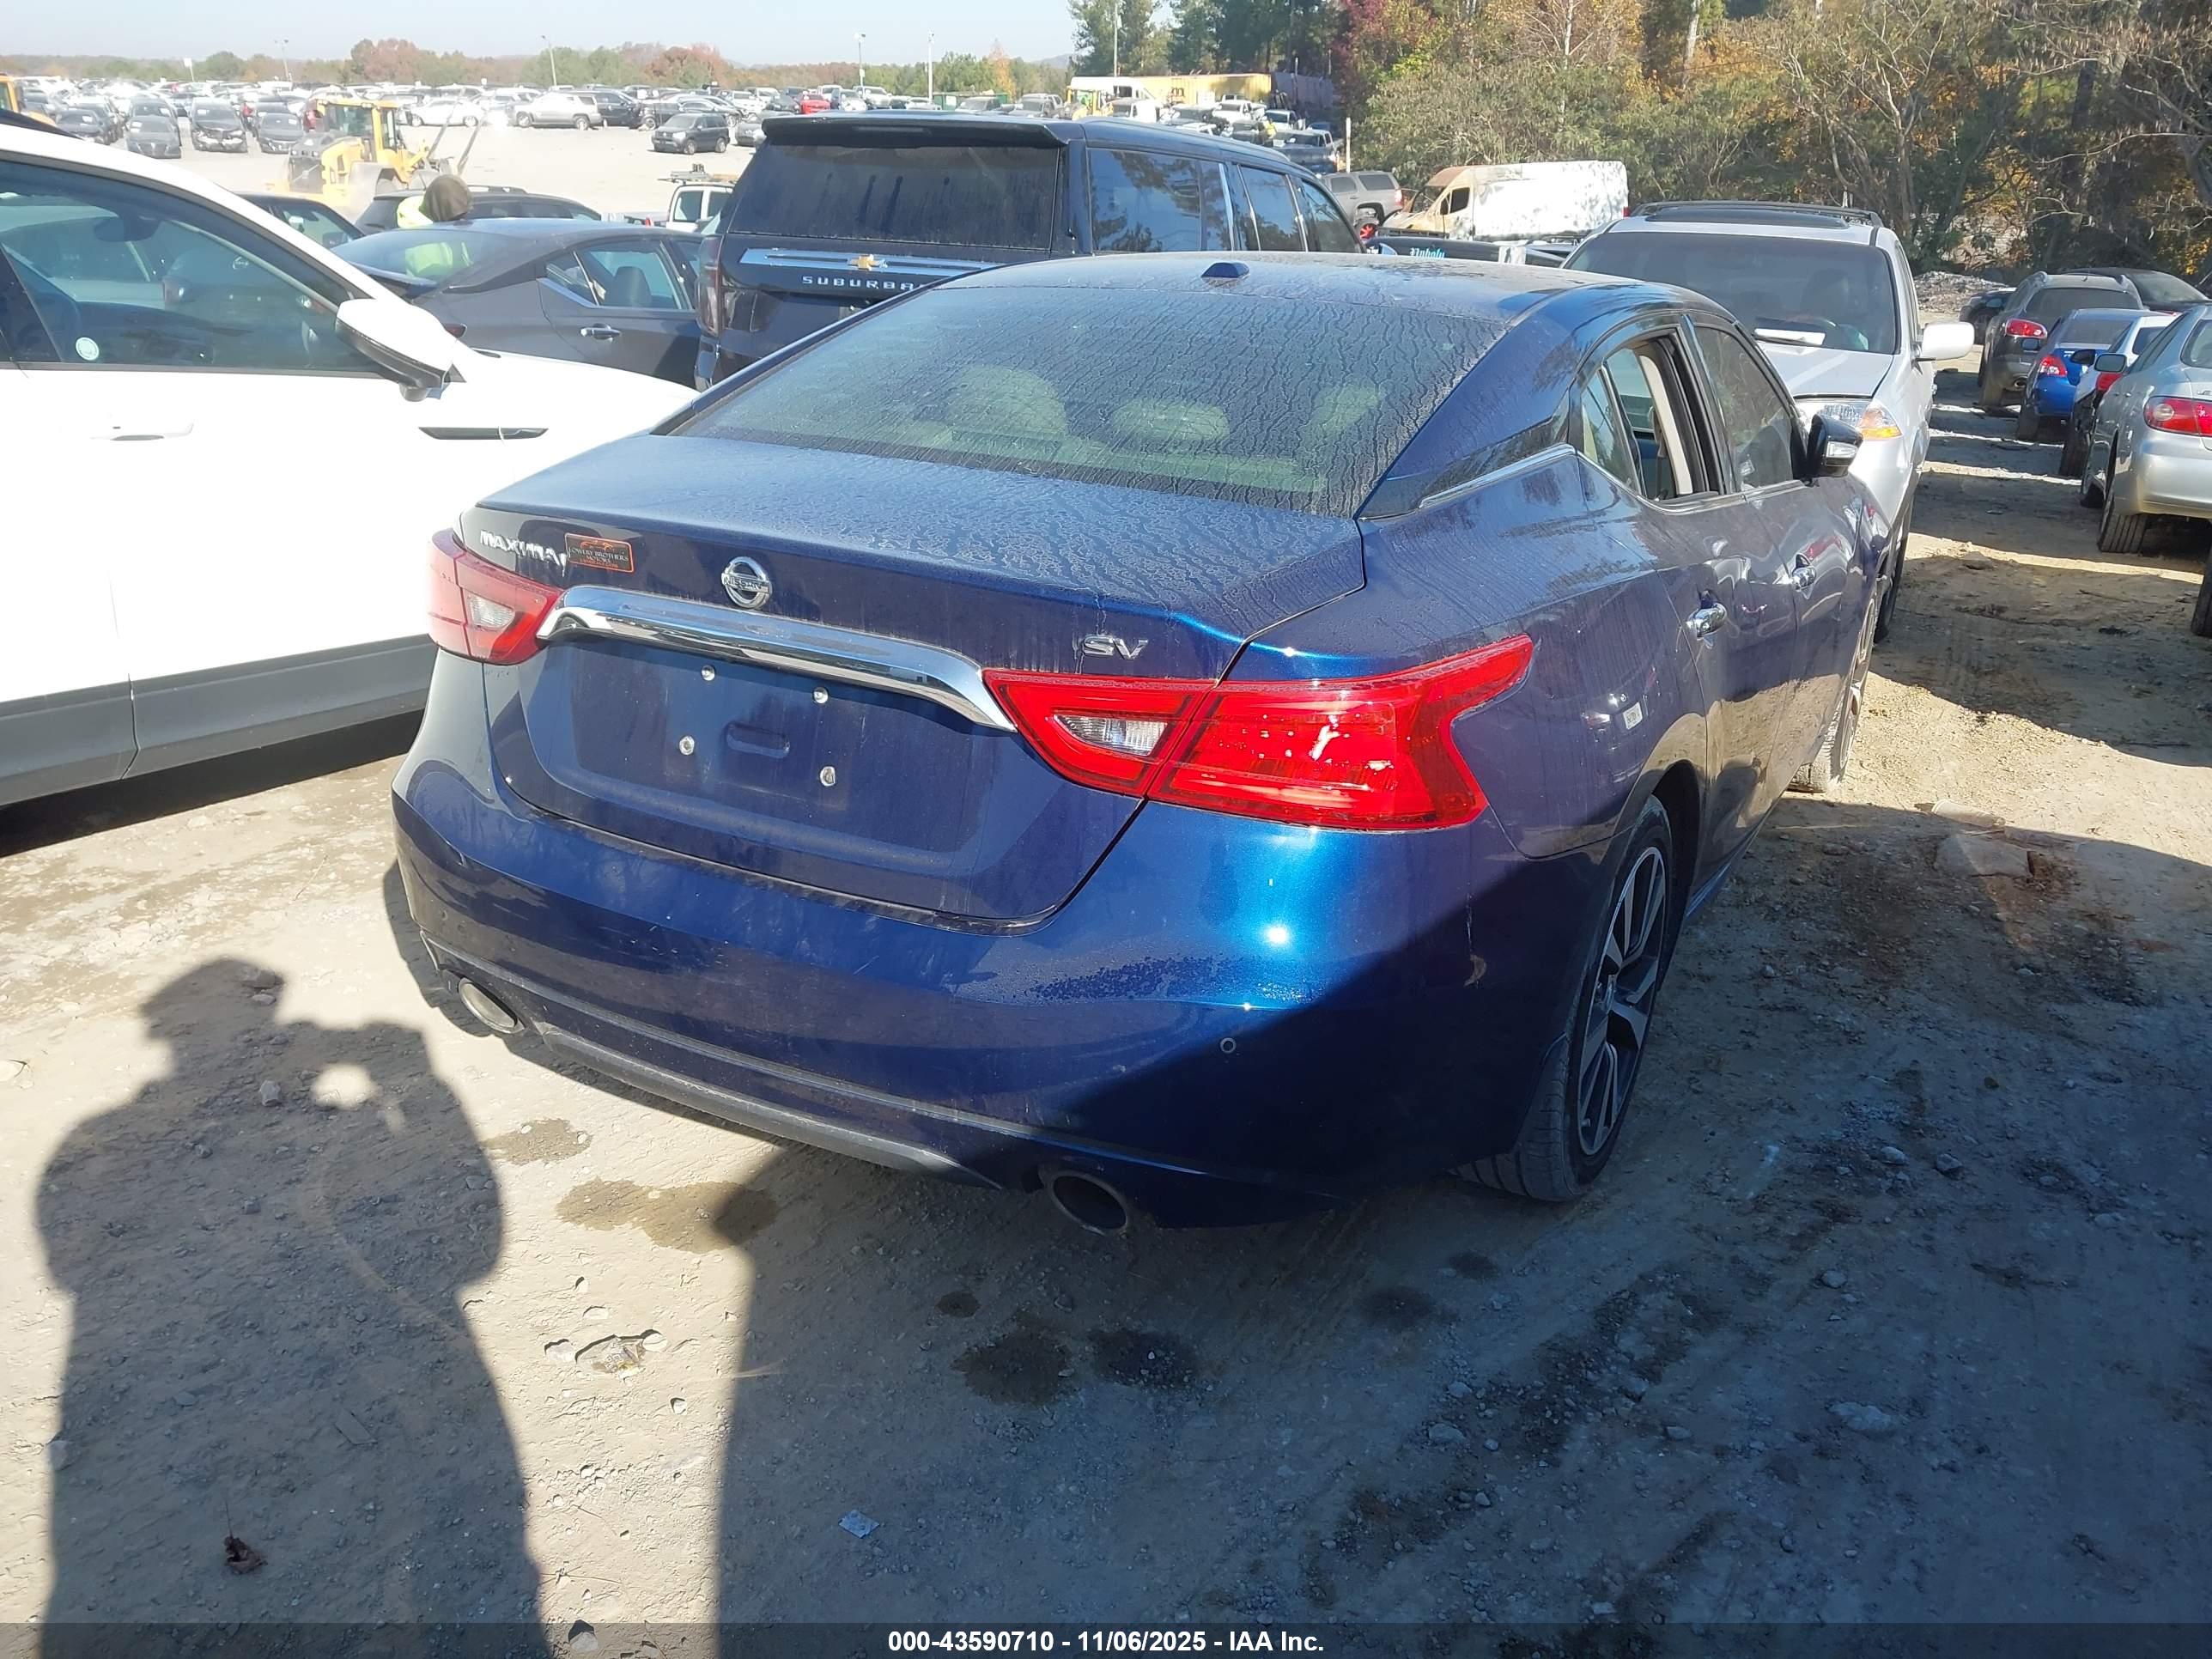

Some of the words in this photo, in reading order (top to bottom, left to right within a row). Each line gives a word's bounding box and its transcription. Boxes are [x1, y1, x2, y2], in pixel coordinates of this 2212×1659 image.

[802, 275, 927, 291] SUBURBA
[723, 574, 762, 591] NISSAN
[1084, 635, 1149, 659] SV
